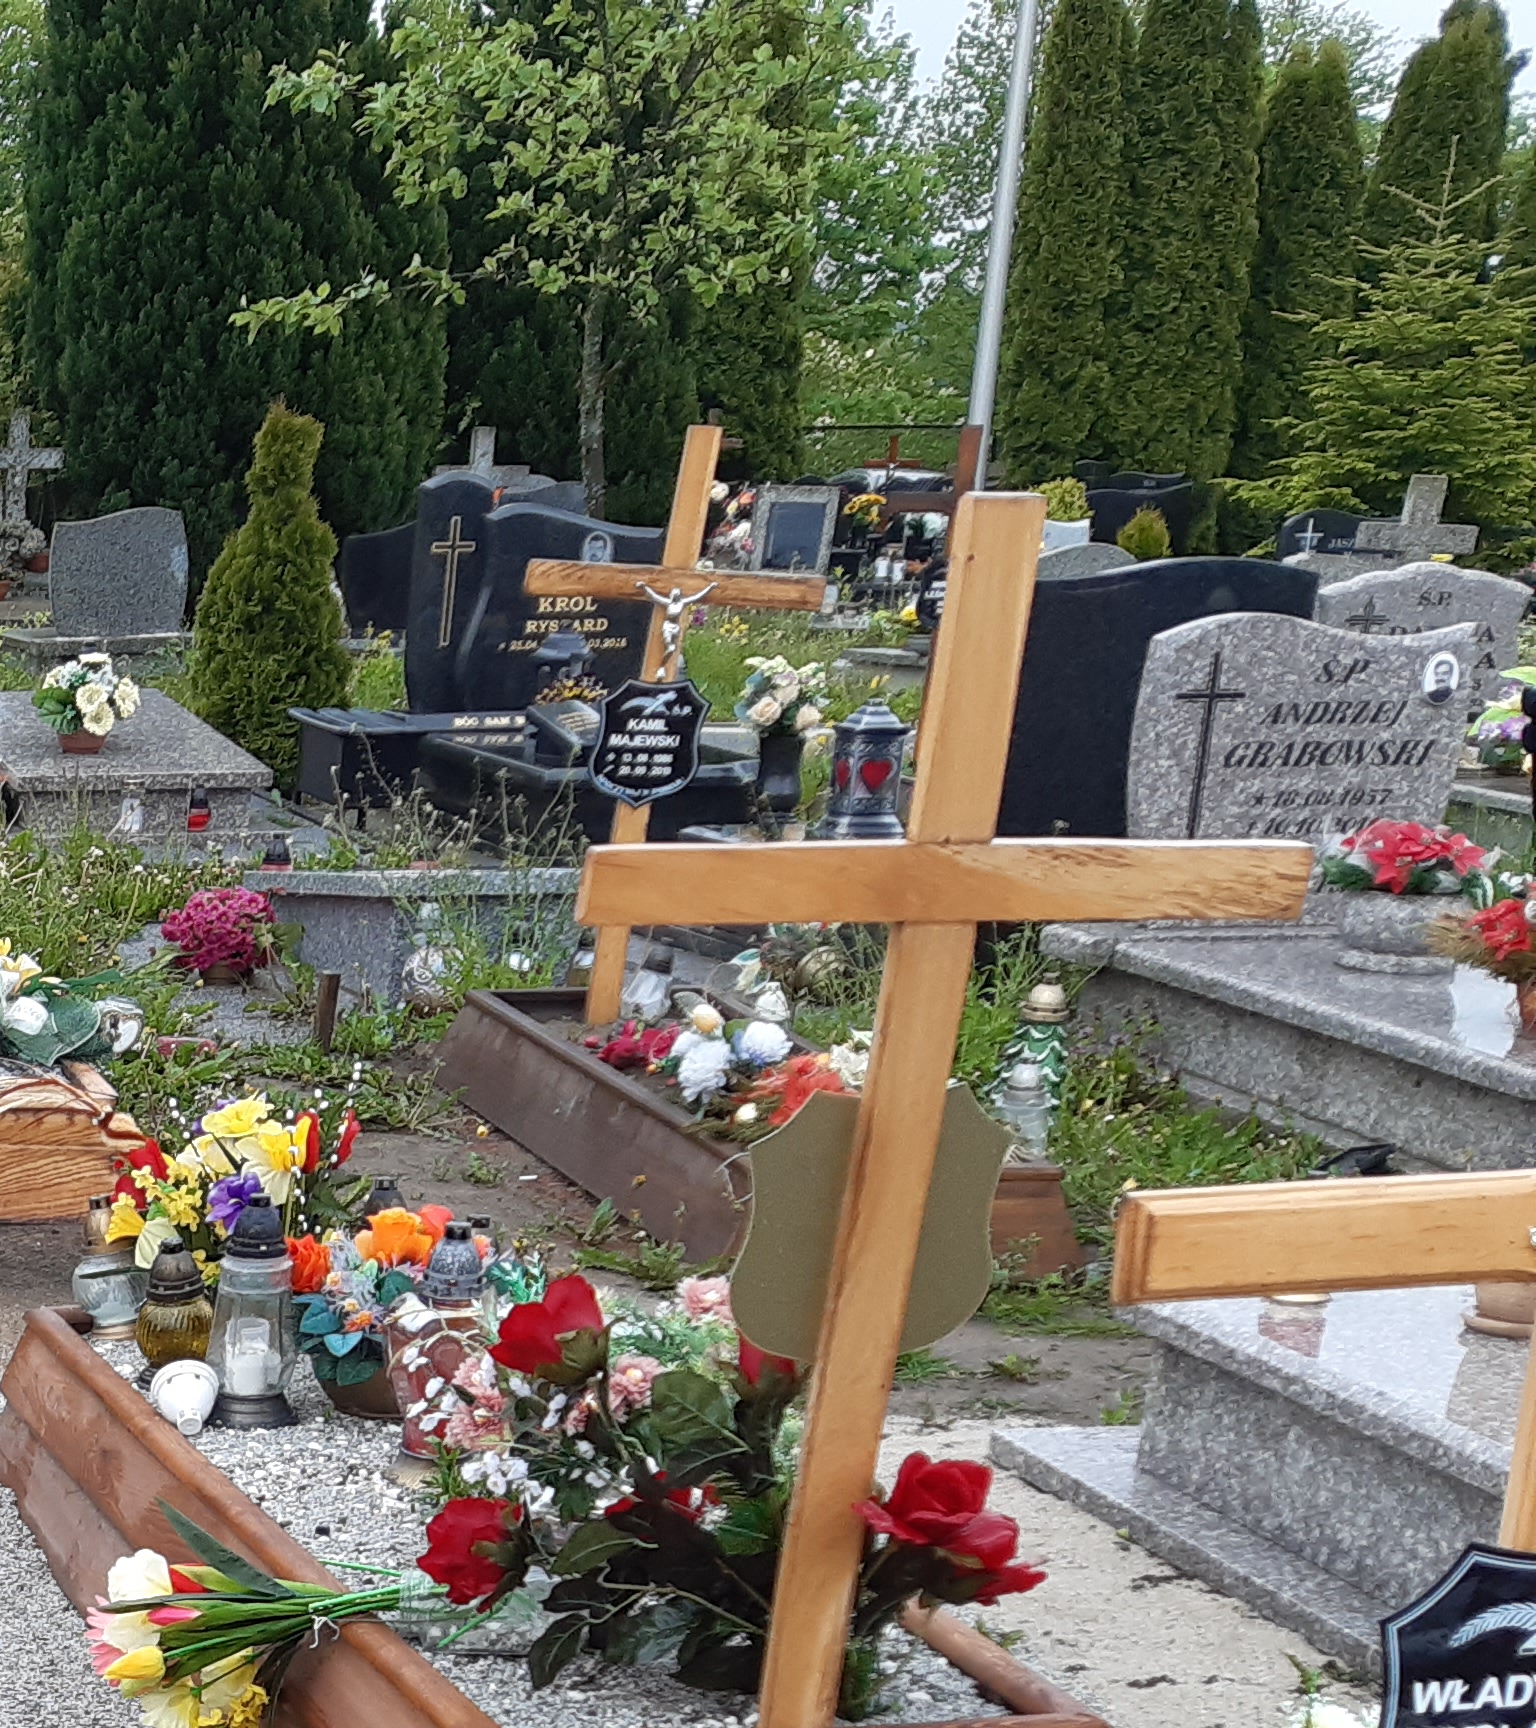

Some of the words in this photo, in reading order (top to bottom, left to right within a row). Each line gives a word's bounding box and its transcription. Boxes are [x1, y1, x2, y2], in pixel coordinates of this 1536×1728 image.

[626, 718, 670, 732] KAMIL
[1259, 699, 1410, 727] ANDRZEJ
[607, 734, 681, 749] MAJEWSKI
[1223, 738, 1436, 769] GRABOWSKI
[1412, 1674, 1536, 1714] WŁAD
